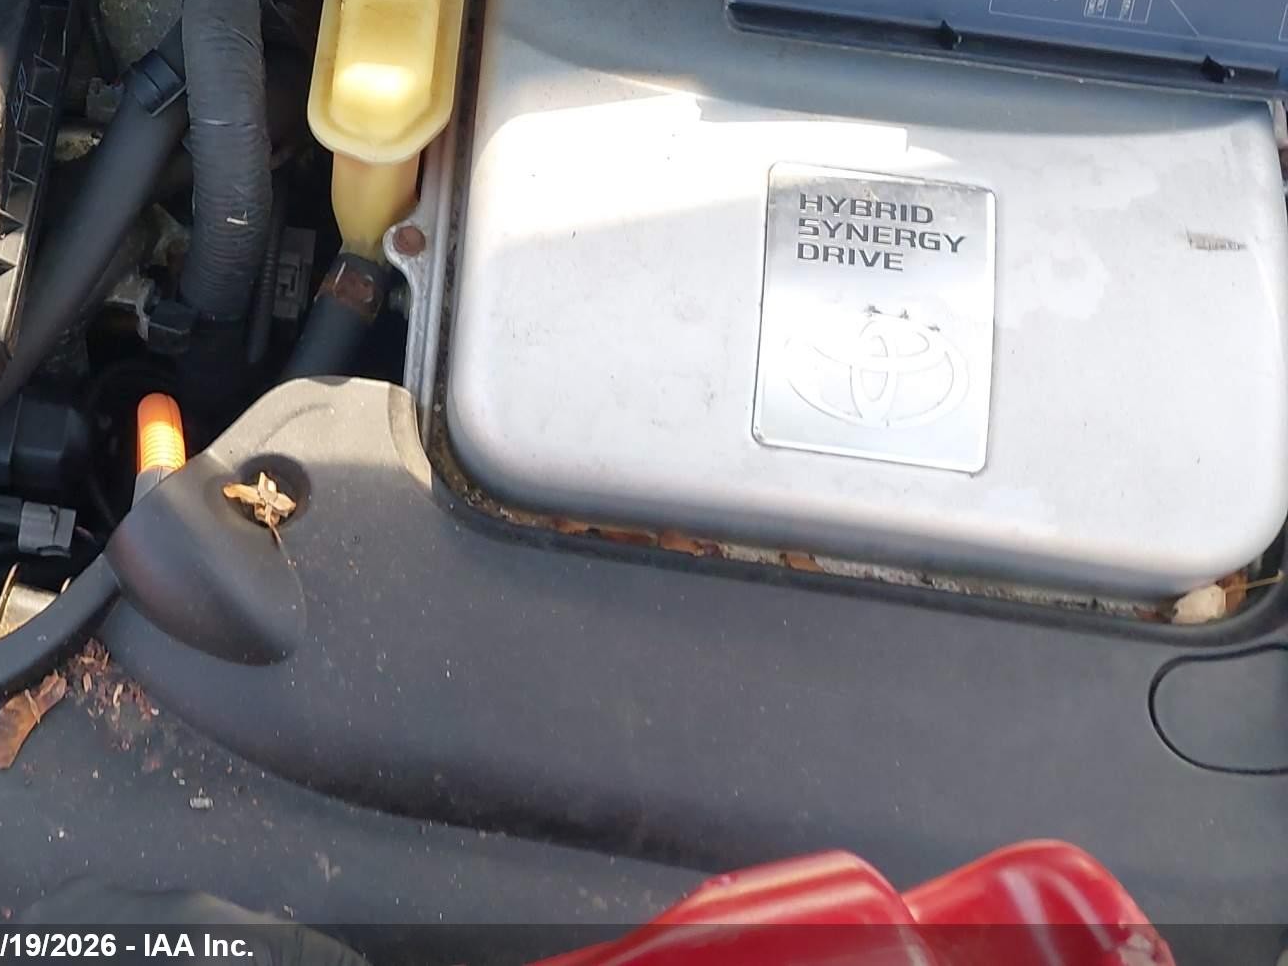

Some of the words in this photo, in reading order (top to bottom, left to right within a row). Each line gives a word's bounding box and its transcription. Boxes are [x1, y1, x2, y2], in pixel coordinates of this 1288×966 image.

[799, 192, 934, 224] HYBRID
[797, 218, 967, 254] SYNERGY
[797, 242, 905, 272] DRIVE
